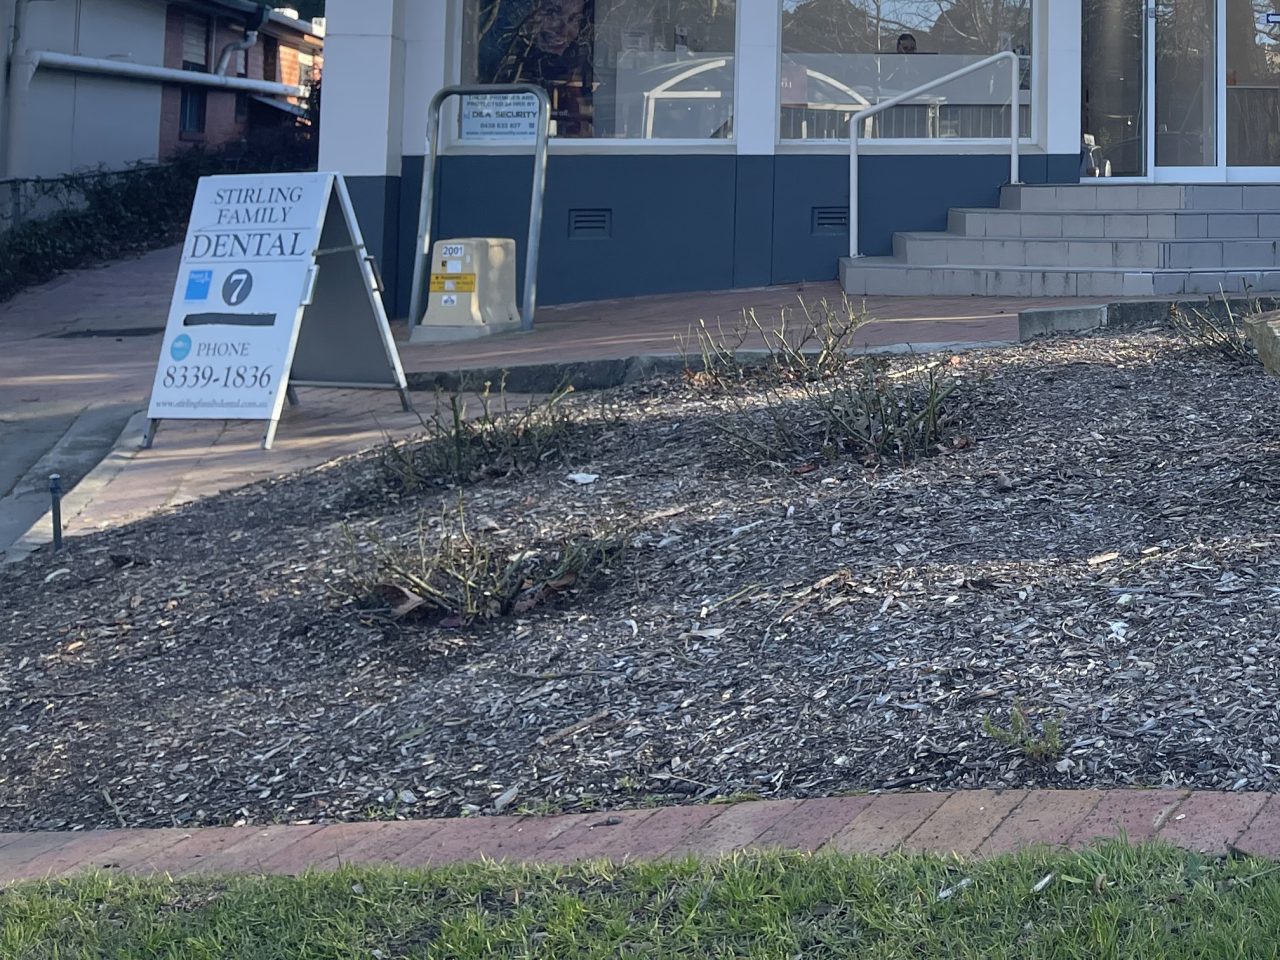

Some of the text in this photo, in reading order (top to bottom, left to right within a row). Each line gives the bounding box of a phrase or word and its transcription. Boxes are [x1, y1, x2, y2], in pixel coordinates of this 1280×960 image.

[214, 187, 303, 205] STIRLING
[217, 206, 293, 225] FAMILY
[190, 232, 306, 259] DENTAL
[442, 246, 463, 255] 2001
[230, 273, 248, 304] 7
[196, 342, 251, 357] PHONE
[163, 364, 273, 389] 8339-1836
